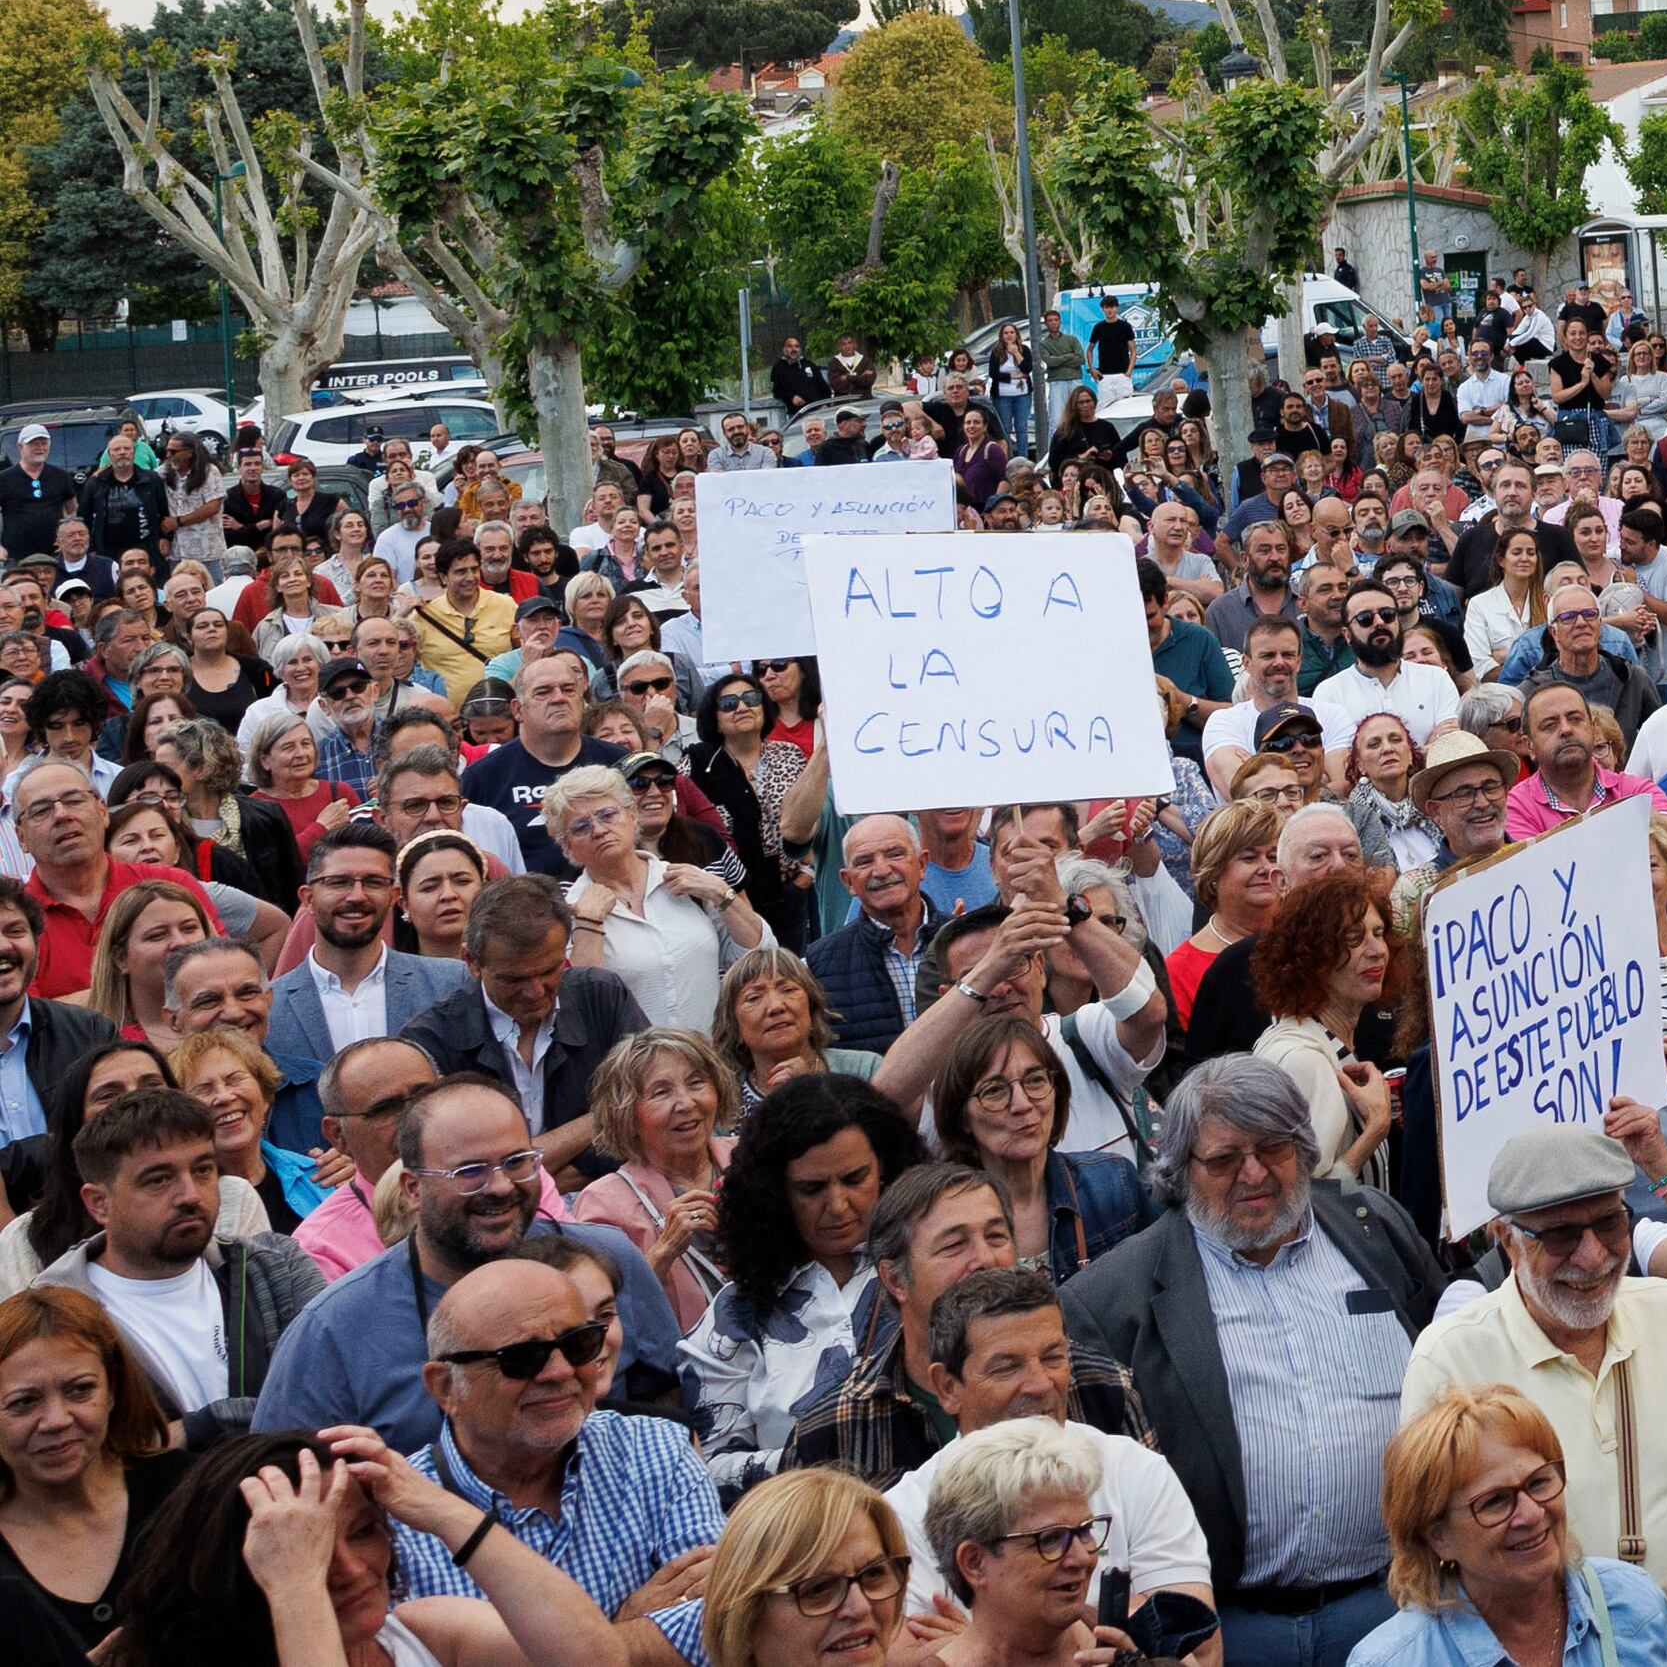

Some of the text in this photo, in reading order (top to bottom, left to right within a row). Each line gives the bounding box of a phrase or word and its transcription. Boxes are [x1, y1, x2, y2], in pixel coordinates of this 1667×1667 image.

[328, 370, 439, 387] INTER POOLS
[724, 494, 935, 518] PACO Y ASUNCIÓN
[845, 565, 1083, 620] ALTO A
[888, 648, 960, 689] LA
[854, 710, 1114, 757] CENSURA
[1552, 861, 1576, 925] Y
[1450, 910, 1605, 1062] ASUNCIÓN
[1453, 960, 1644, 1122] DE ESTE PUEBLO
